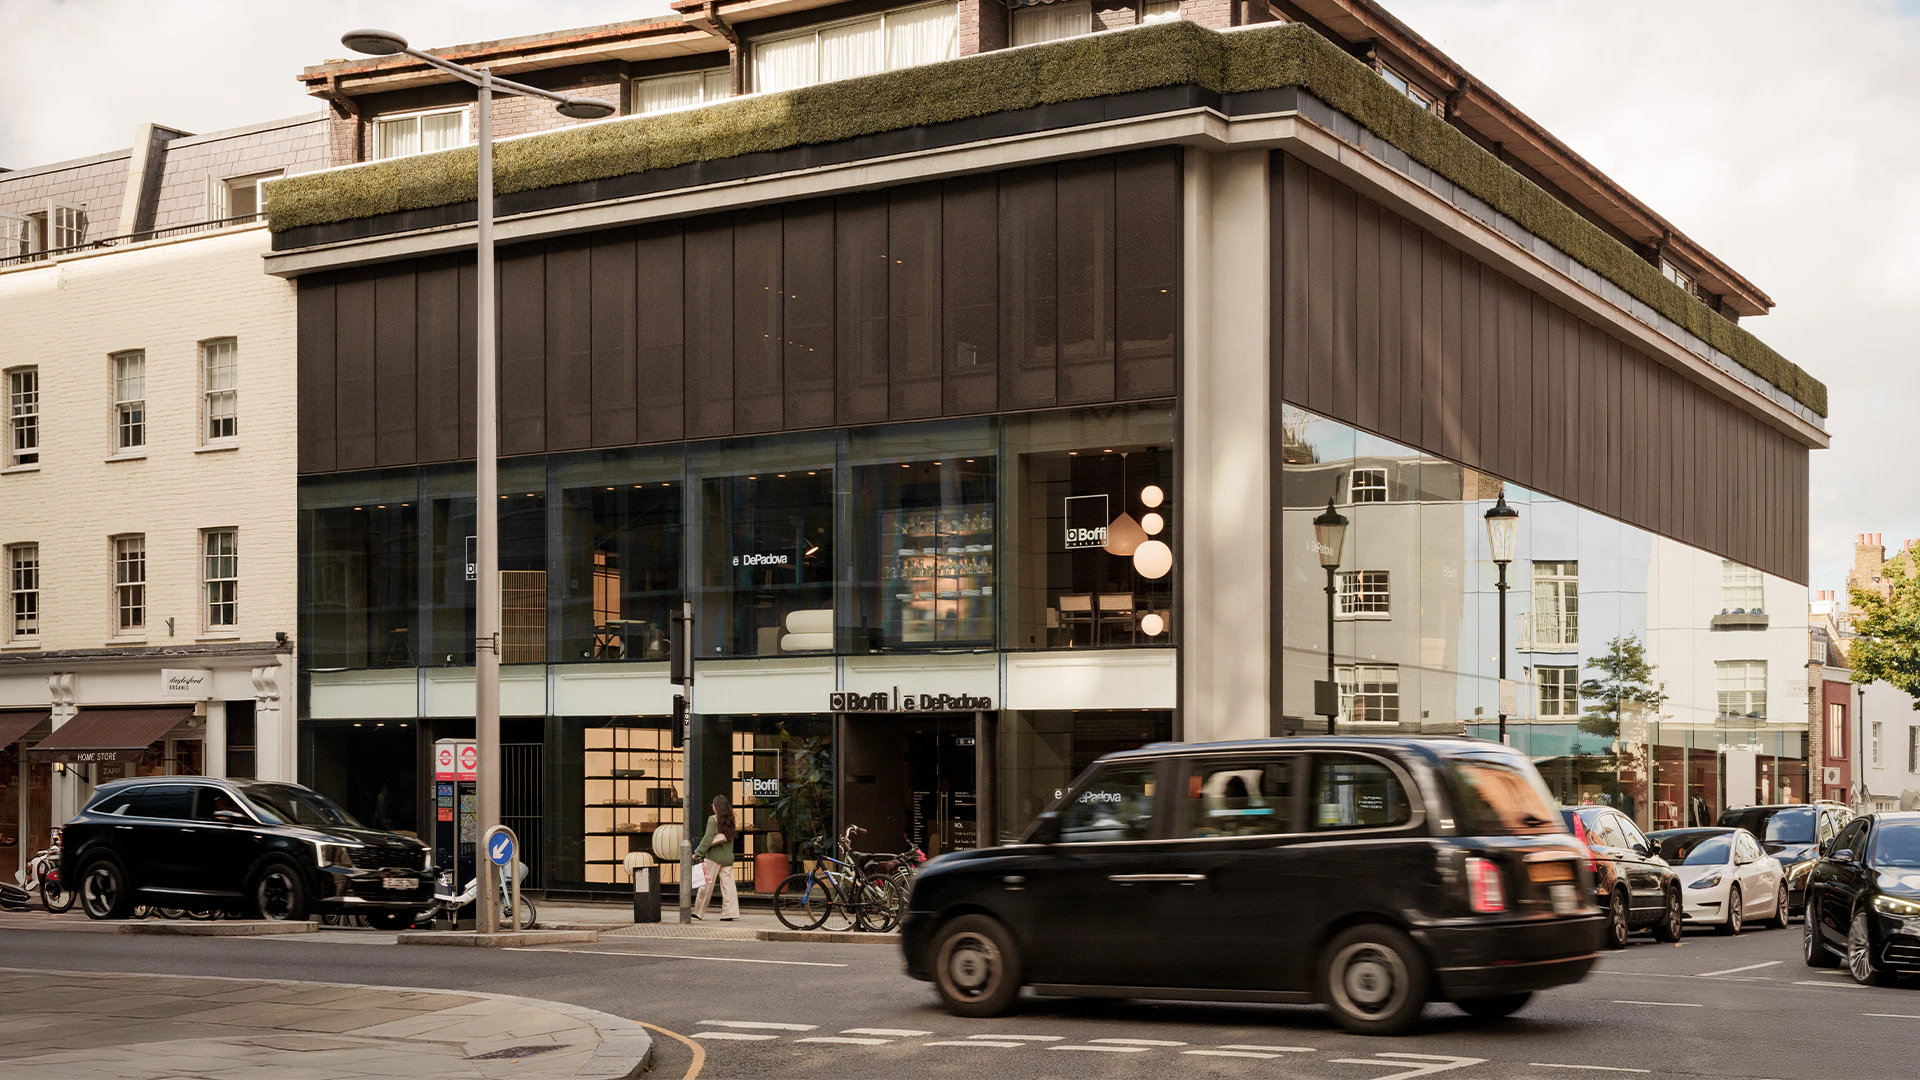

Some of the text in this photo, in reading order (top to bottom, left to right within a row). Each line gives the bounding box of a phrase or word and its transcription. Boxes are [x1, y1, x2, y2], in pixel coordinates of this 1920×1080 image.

[1078, 527, 1107, 541] Boffi
[743, 553, 788, 566] DePadova
[847, 691, 889, 711] Boffi
[920, 693, 992, 710] DePadova
[77, 752, 117, 761] HOME STORE
[753, 778, 778, 791] Boffi
